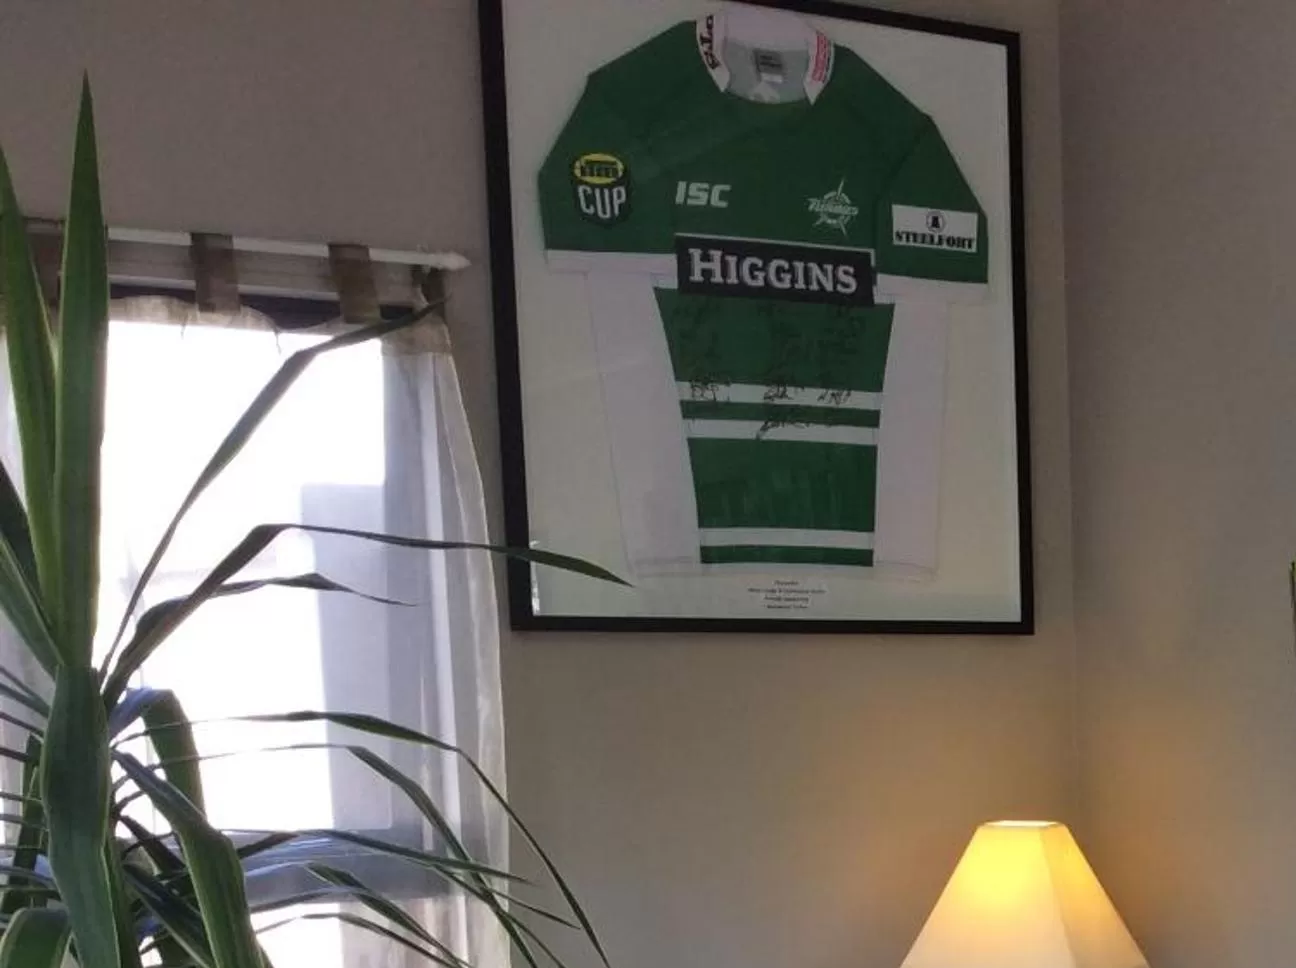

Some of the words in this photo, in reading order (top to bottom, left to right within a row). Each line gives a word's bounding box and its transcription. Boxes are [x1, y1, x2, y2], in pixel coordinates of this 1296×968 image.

[577, 184, 627, 219] CUP
[675, 180, 732, 209] ISC
[687, 247, 859, 295] HIGGINS
